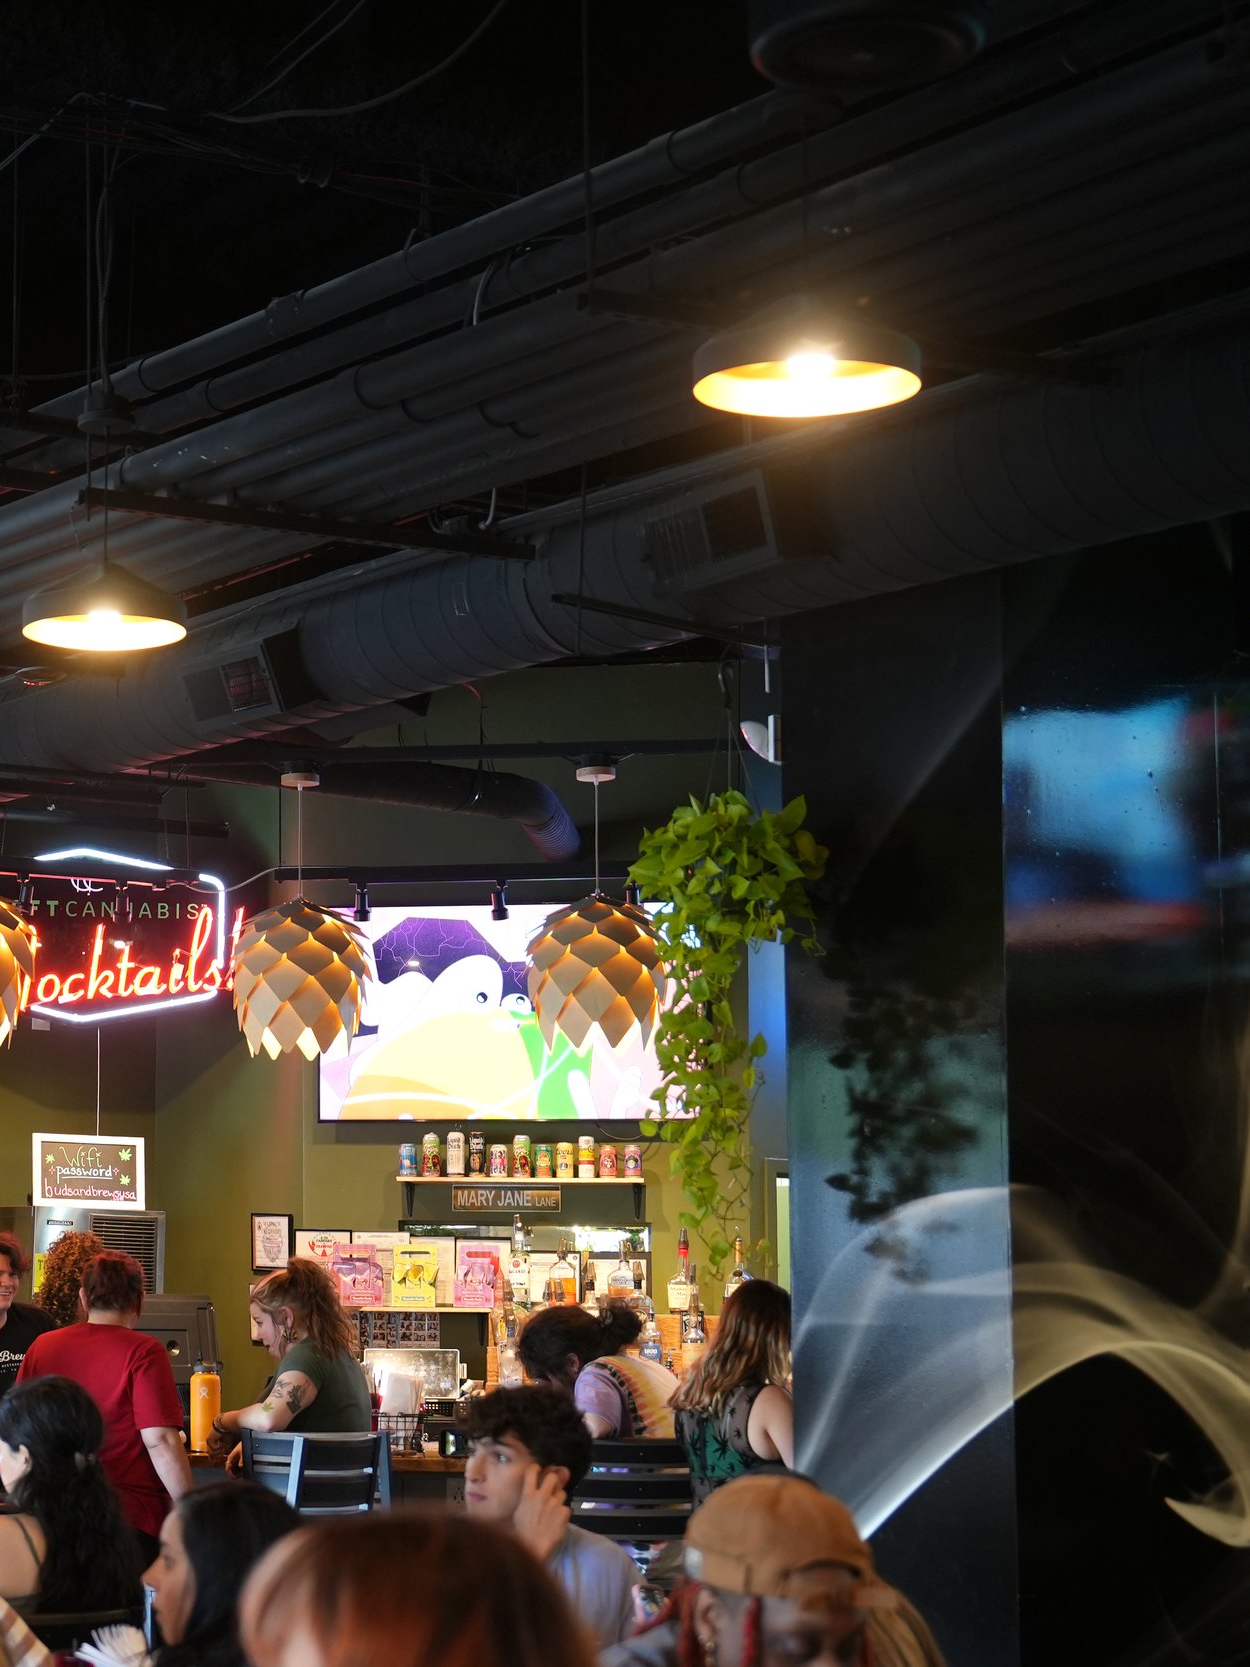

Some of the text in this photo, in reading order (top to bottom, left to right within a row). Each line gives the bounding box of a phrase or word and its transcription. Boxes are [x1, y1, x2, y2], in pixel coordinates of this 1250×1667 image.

[65, 901, 200, 920] CANABIS
[59, 1146, 102, 1167] Wifi
[56, 1165, 112, 1184] password
[457, 1190, 556, 1206] MARY JANE LANE
